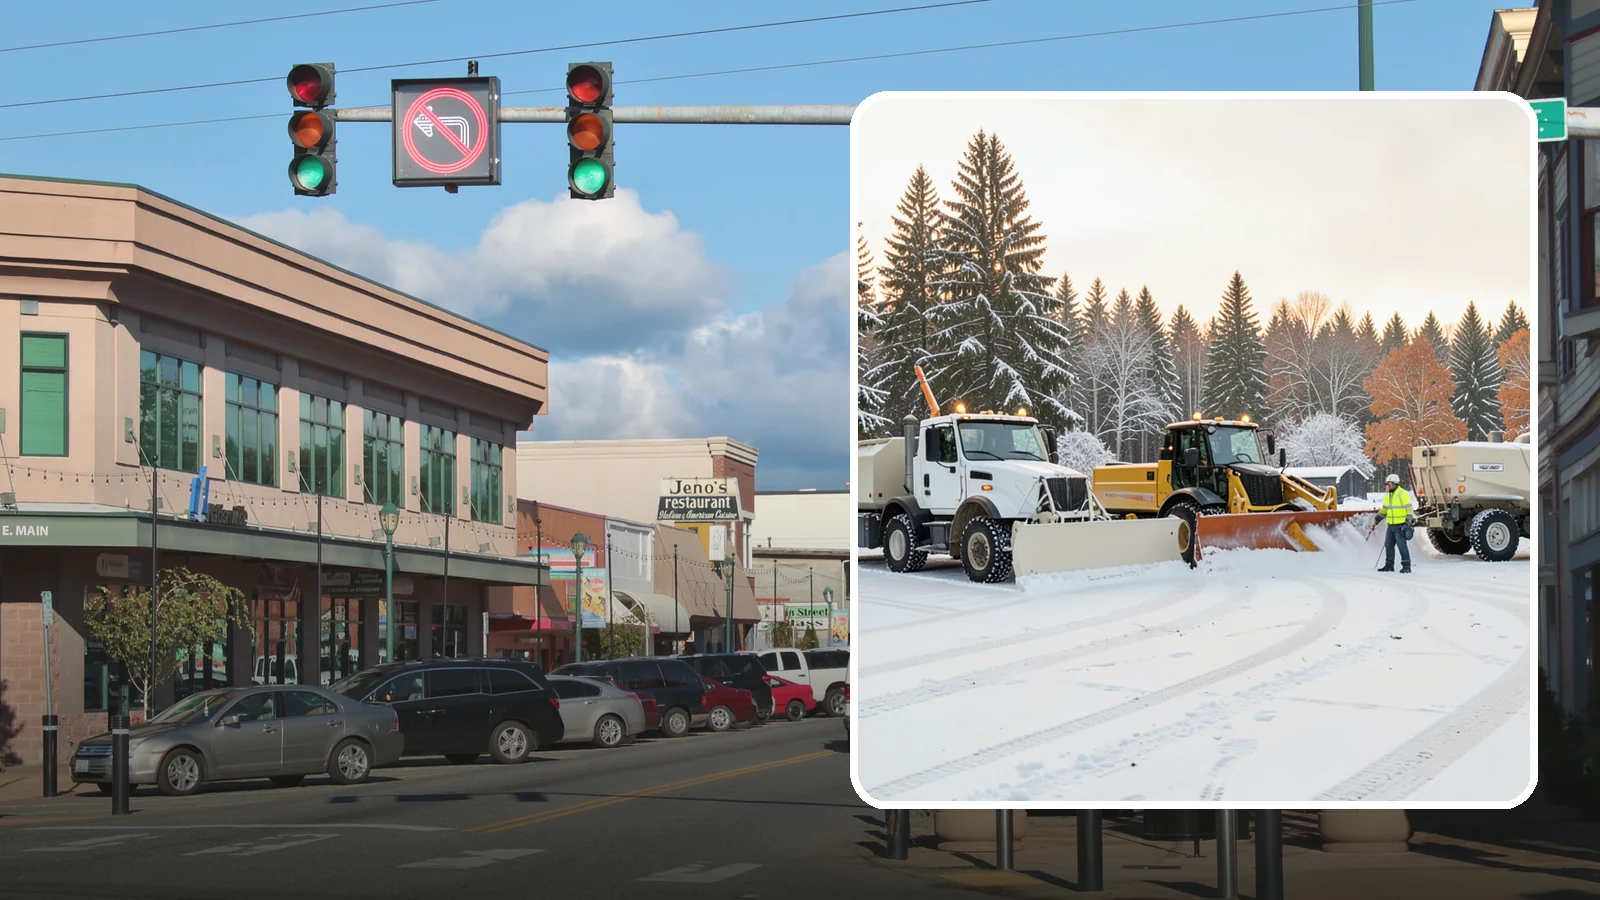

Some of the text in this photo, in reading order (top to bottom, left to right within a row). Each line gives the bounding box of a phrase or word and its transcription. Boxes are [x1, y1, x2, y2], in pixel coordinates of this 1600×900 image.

[670, 480, 727, 494] Jeno's
[665, 496, 731, 509] restaurant
[658, 510, 681, 519] Italian
[686, 510, 714, 519] American
[715, 509, 737, 519] Cuisine
[2, 525, 49, 536] E. MAIN
[797, 607, 829, 617] Street
[790, 619, 824, 628] lass
